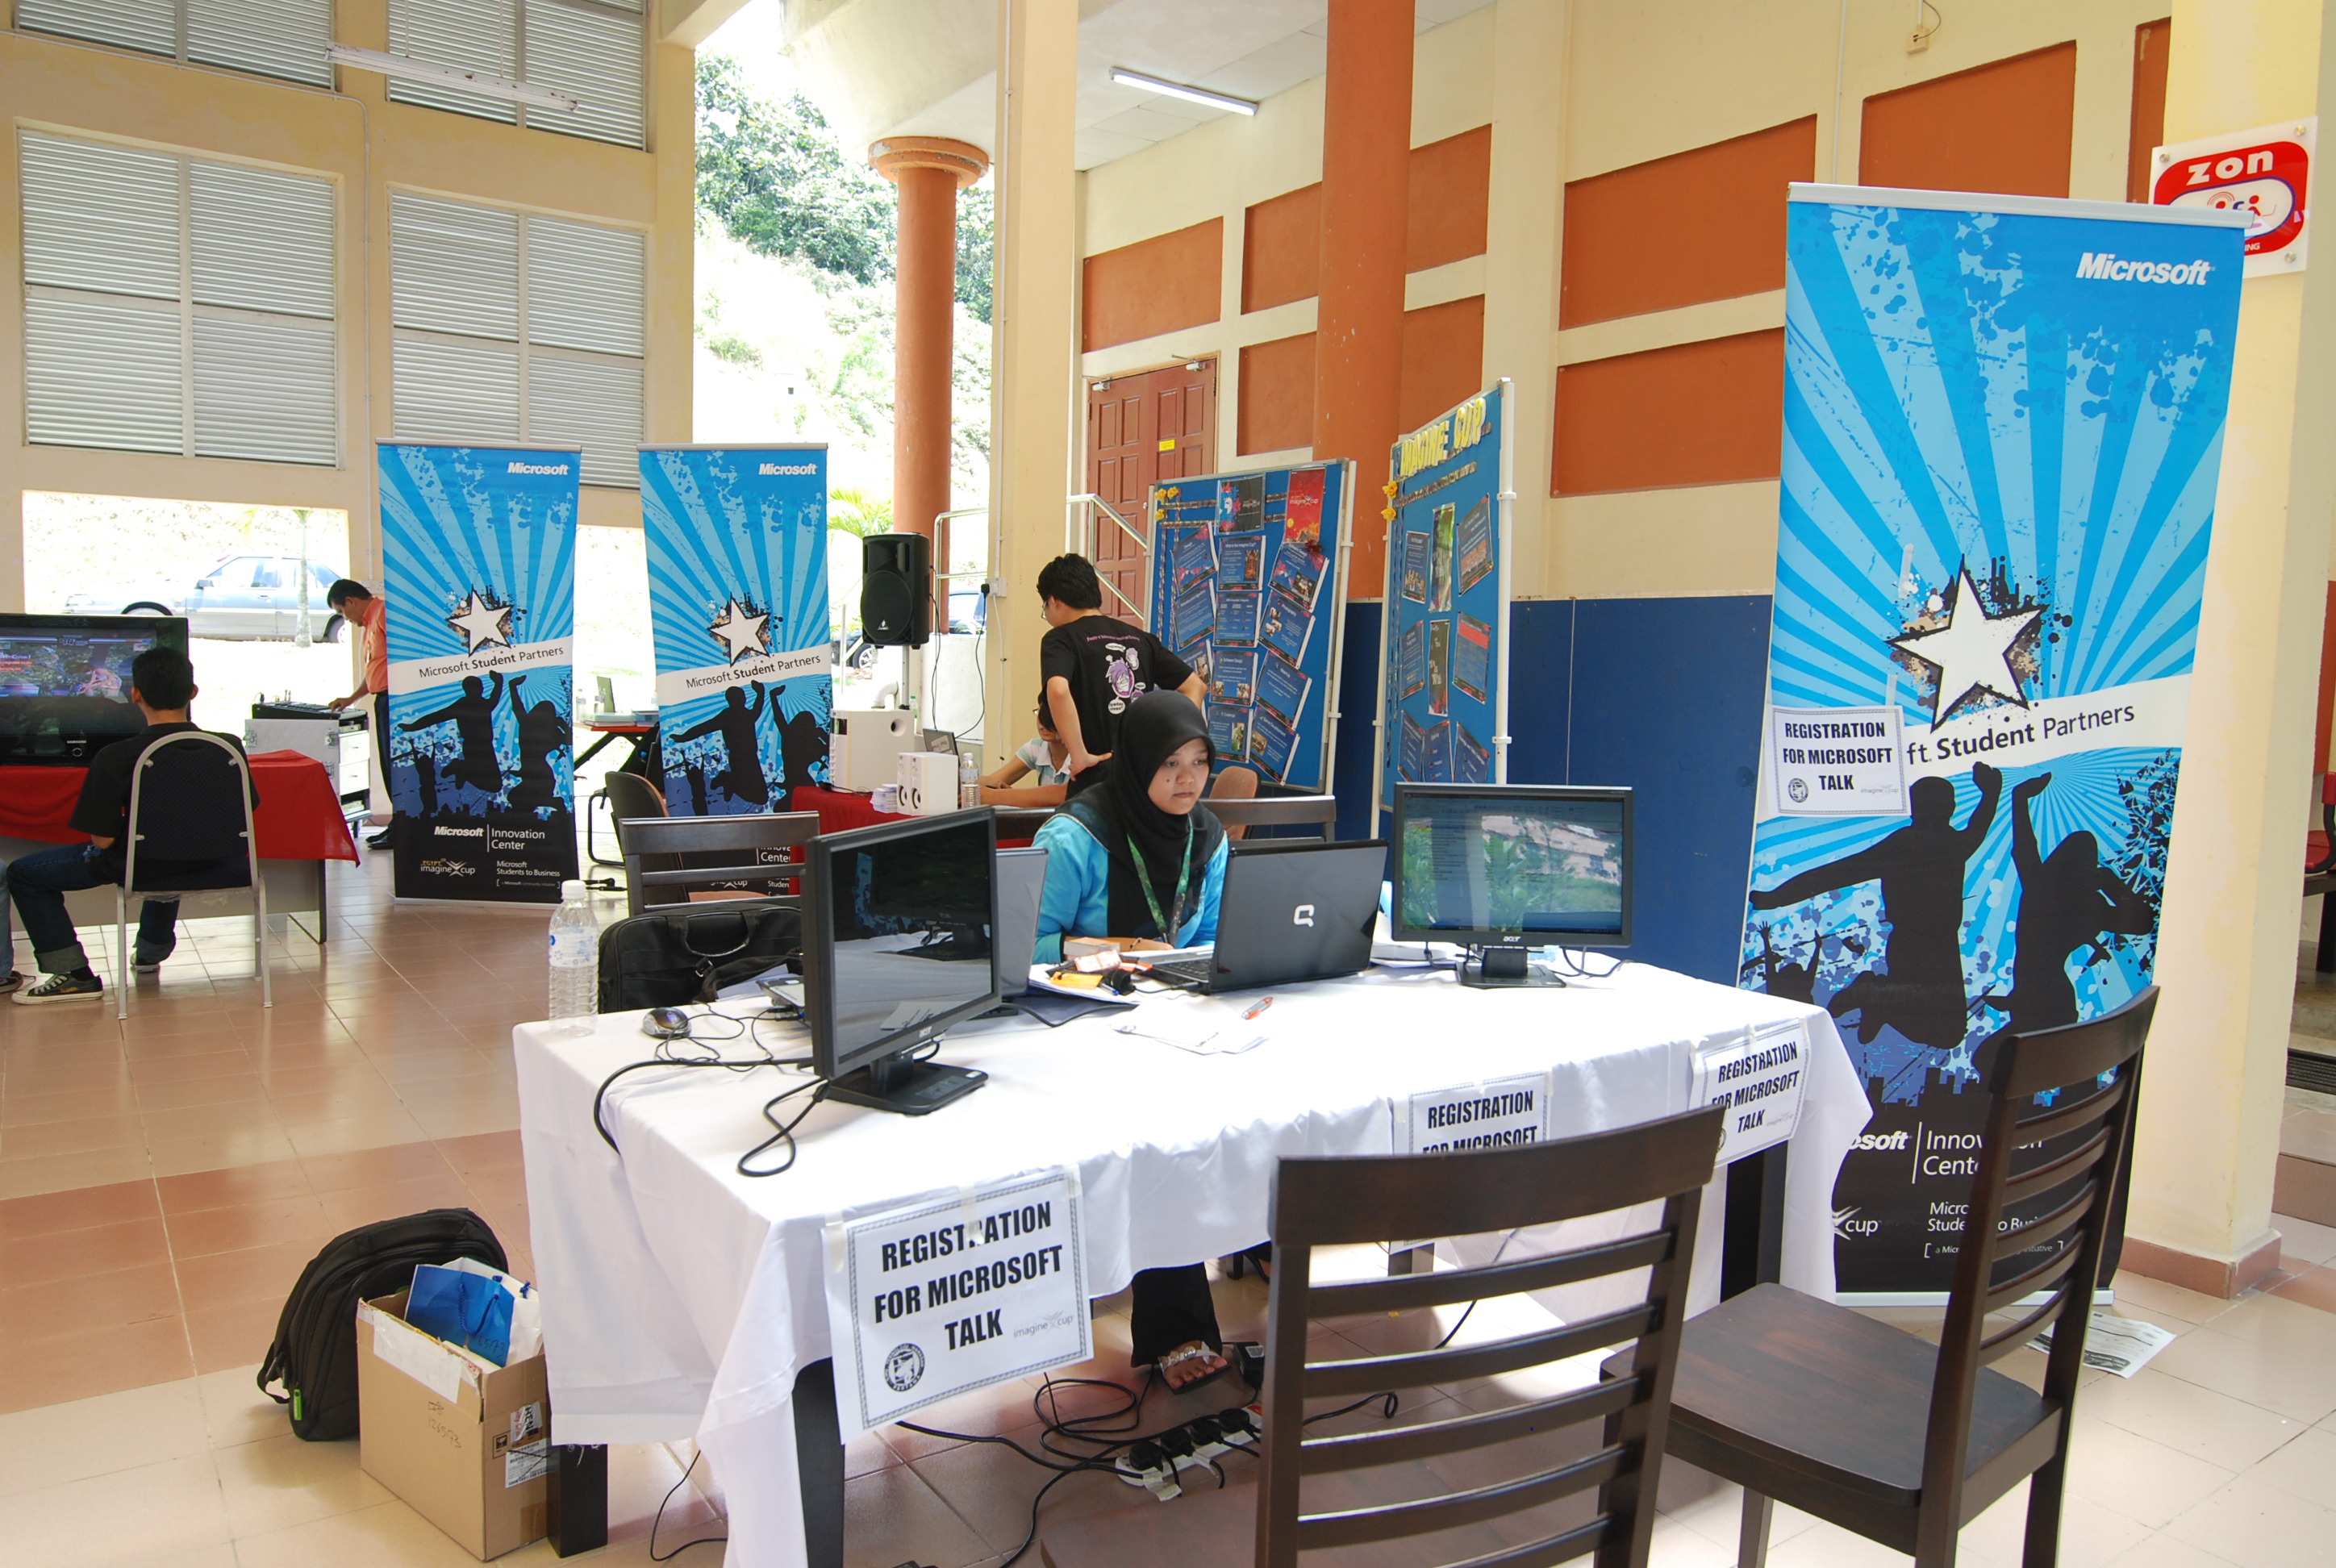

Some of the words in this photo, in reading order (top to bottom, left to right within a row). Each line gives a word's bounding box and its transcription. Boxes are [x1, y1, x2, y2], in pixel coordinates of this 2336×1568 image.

[2186, 151, 2273, 186] zon
[2075, 252, 2211, 286] Microsoft
[1400, 419, 1450, 477] IMAGINE
[1454, 398, 1486, 448] CUP
[507, 461, 568, 476] Microsoft
[759, 463, 816, 476] Microsoft
[419, 661, 470, 678] Microsoft
[472, 653, 516, 669] Student
[519, 647, 564, 661] Partners
[686, 671, 732, 689] Microsoft
[733, 663, 775, 679] Student
[777, 655, 821, 670] Partners
[1785, 722, 1885, 739] REGISTRATION
[1937, 723, 2035, 760] Student
[2043, 705, 2135, 739] Partners
[1783, 748, 1805, 764] FOR
[1808, 748, 1892, 765] MICROSOFT
[1818, 774, 1854, 790] TALK
[434, 826, 484, 836] Microsoft
[491, 828, 545, 840] Innovation
[491, 840, 525, 849] Center
[420, 864, 452, 874] imagine
[461, 867, 476, 876] cup
[497, 860, 527, 868] Microsoft
[497, 868, 524, 876] Students
[768, 880, 789, 888] Studen
[1718, 1041, 1798, 1083] REGISTRATION
[1733, 1070, 1800, 1107] MICROSOFT
[1428, 1090, 1533, 1129] REGISTRATION
[1737, 1109, 1765, 1133] TALK
[1845, 1220, 1879, 1236] cup
[1928, 1218, 1965, 1232] Stude
[874, 1285, 921, 1324] FOR
[928, 1245, 1063, 1308] MICROSOFT
[945, 1308, 1003, 1350] TALK
[1013, 1321, 1048, 1338] imagine
[1057, 1315, 1074, 1328] cup
